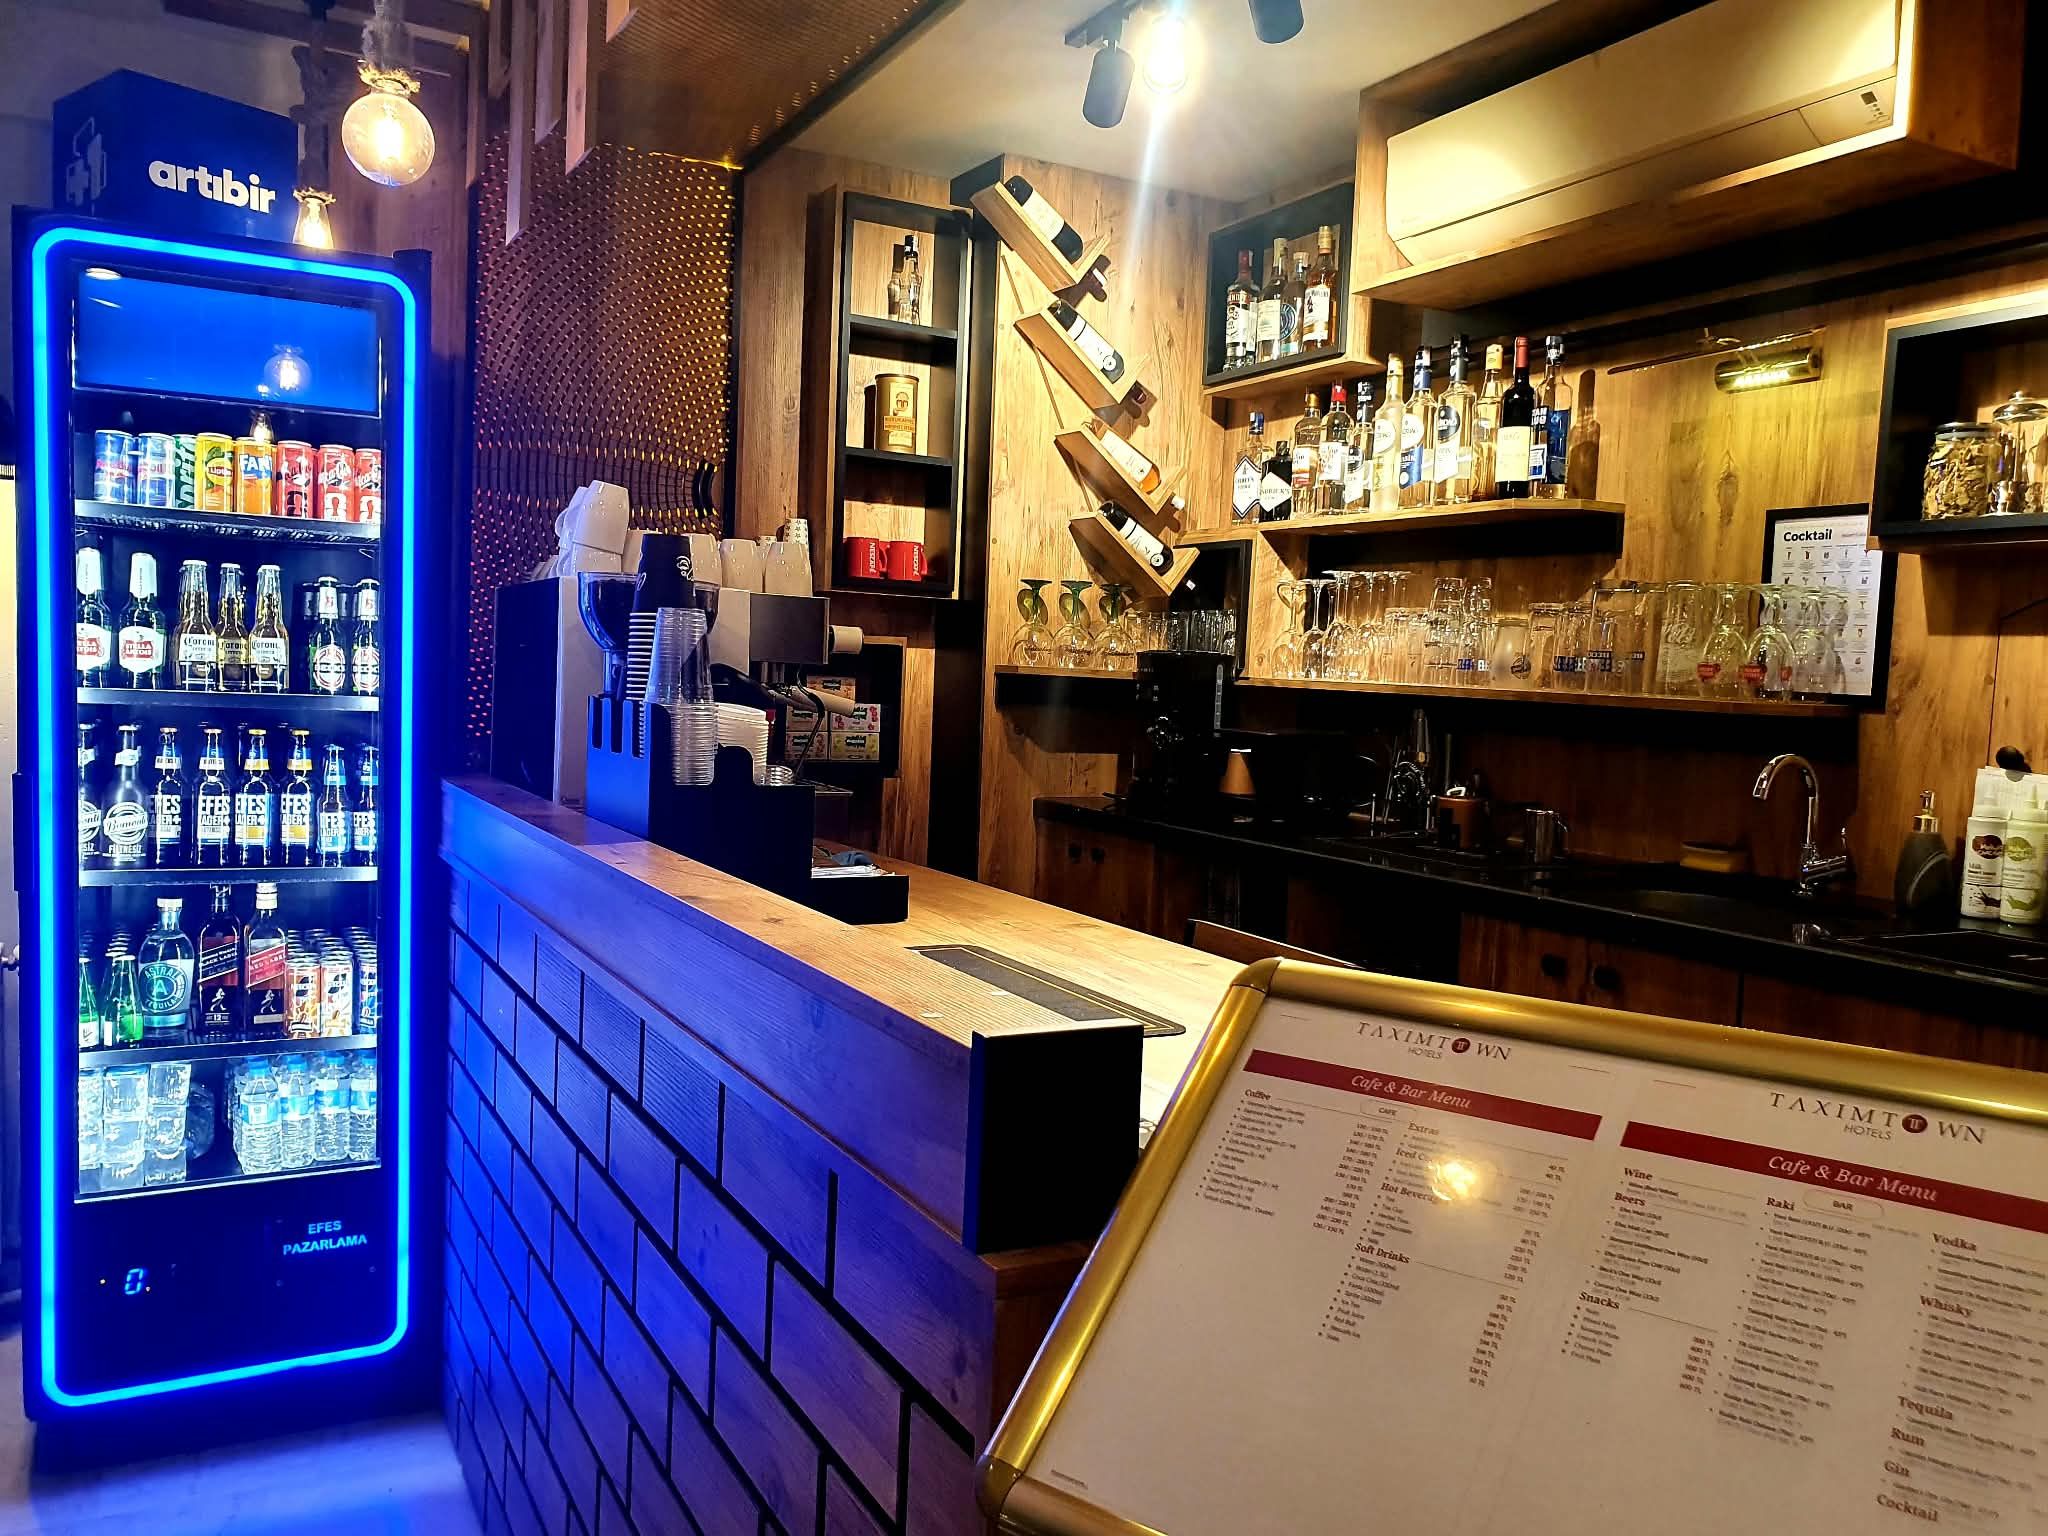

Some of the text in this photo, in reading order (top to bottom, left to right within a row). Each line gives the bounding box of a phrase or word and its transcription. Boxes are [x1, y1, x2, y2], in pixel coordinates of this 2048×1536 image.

[1783, 528, 1833, 542] Cocktail
[199, 796, 230, 816] EFES
[281, 794, 310, 814] EFES
[144, 964, 181, 980] ASTRAL
[152, 980, 168, 996] A
[1408, 1046, 1443, 1060] HOTELS
[1351, 1074, 1472, 1109] Cafe & Bar Menu
[1408, 1122, 1439, 1136] Extras
[1843, 1123, 1892, 1141] HOTELS
[1395, 1147, 1417, 1159] Iced
[1624, 1167, 1653, 1181] Wine
[1768, 1154, 1938, 1202] Cafe & Bar Menu
[1380, 1182, 1399, 1193] Hot
[1614, 1192, 1646, 1206] Beers
[1766, 1196, 1795, 1211] Raki
[1832, 1200, 1853, 1211] BAR
[308, 1220, 342, 1234] EFES
[282, 1233, 368, 1255] PAZARLAMA
[1932, 1232, 1976, 1252] Vodka
[1354, 1242, 1410, 1264] Soft Drinks
[124, 1267, 144, 1295] 0
[1578, 1290, 1620, 1310] Snacks
[1920, 1294, 1974, 1318] Whisky
[1897, 1395, 1953, 1421] Tequila
[1890, 1427, 1925, 1447] Rum
[1884, 1459, 1910, 1478] Gin
[1876, 1494, 1939, 1522] Cocktail
